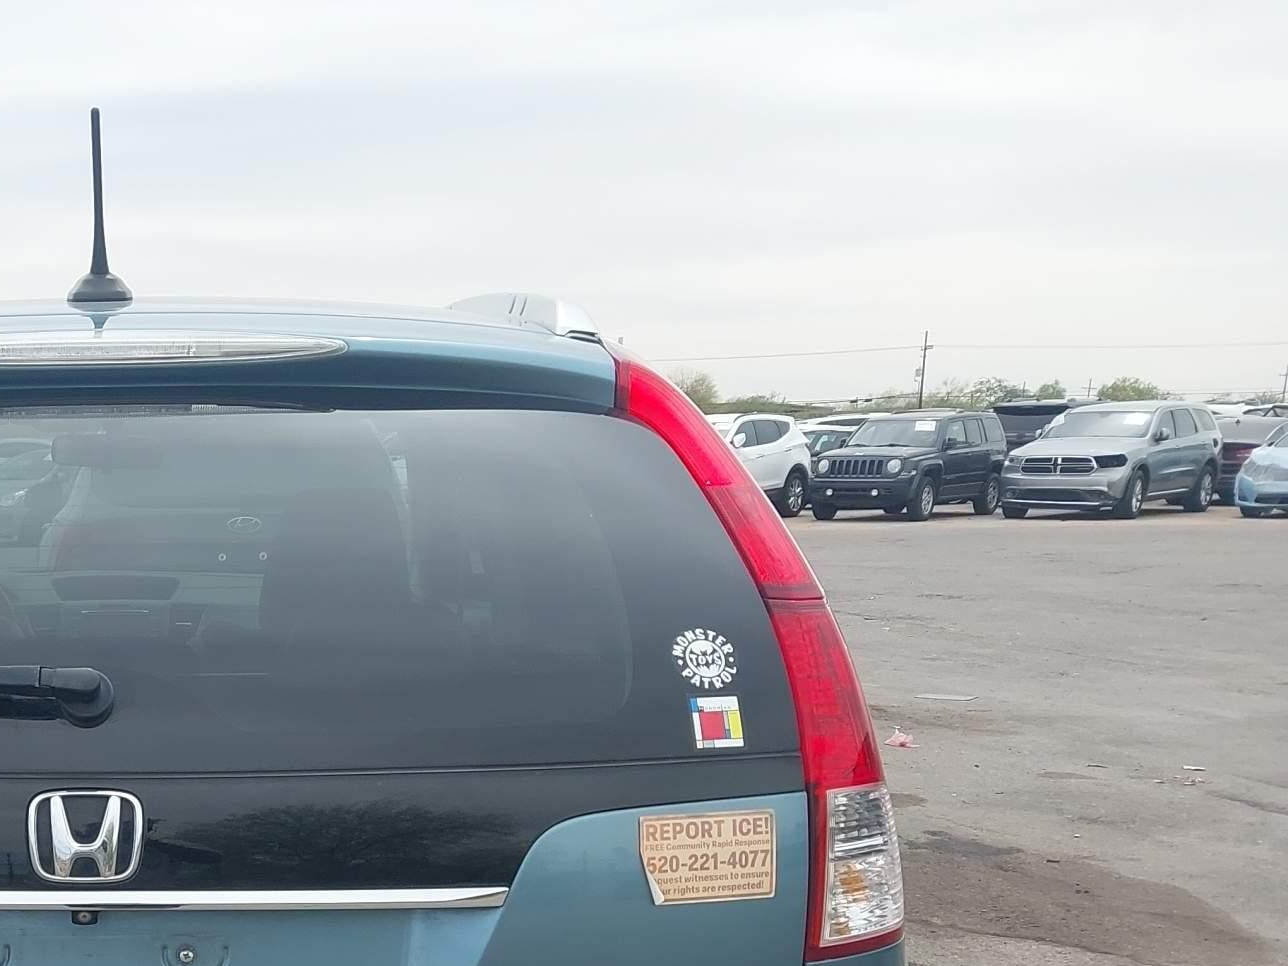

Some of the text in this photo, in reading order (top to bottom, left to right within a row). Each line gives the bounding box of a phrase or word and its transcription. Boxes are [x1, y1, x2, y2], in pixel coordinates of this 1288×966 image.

[672, 628, 733, 657] MONSTER
[690, 652, 721, 666] TOYS
[681, 666, 737, 688] PATROL
[645, 816, 769, 841] REPORT ICE!
[645, 839, 770, 852] FREE Community Rapid Response
[646, 849, 770, 873] 520-221-4077
[655, 875, 682, 886] quest
[684, 873, 728, 883] witnesses
[740, 871, 770, 879] ensure
[673, 885, 700, 896] rights
[702, 885, 716, 893] are
[718, 881, 764, 892] respected!
